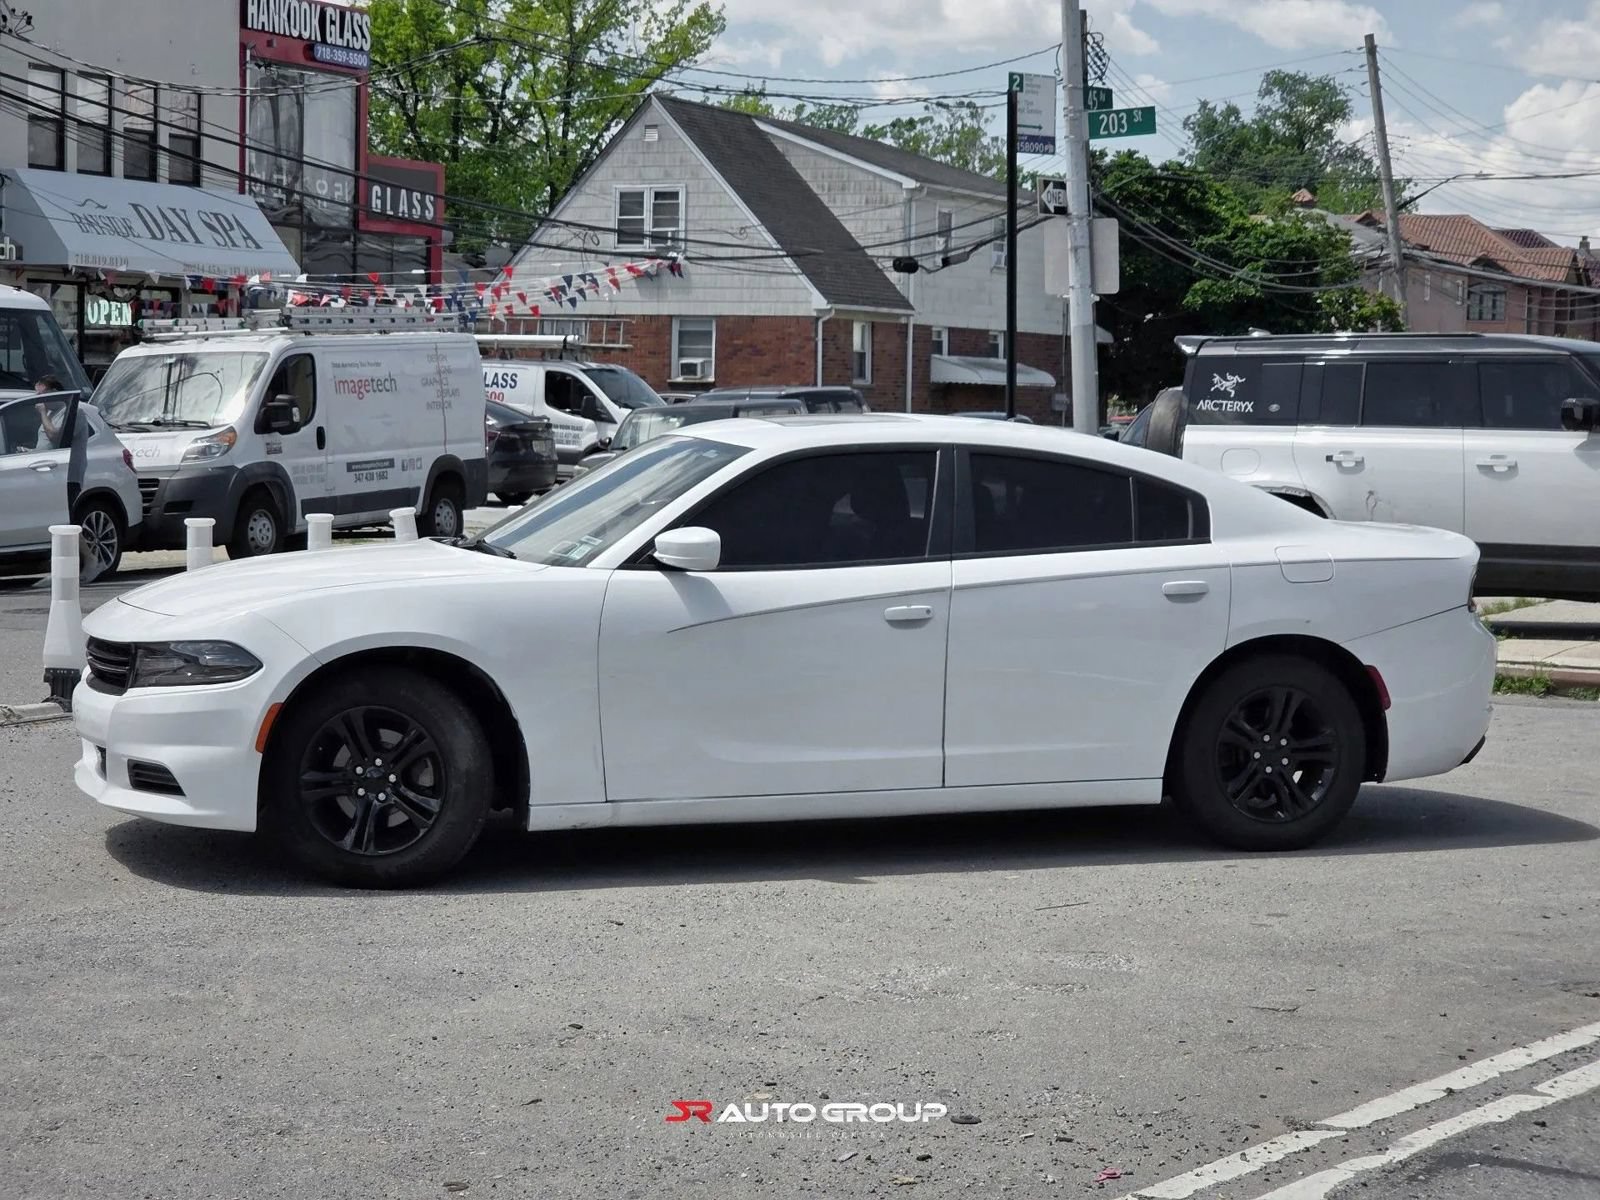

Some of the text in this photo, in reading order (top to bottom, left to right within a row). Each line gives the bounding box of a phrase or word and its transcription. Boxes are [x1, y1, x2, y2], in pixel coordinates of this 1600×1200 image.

[247, 0, 371, 52] HANKOOK GLASS
[316, 46, 368, 67] 718-359-5500
[1012, 75, 1020, 92] 2
[1099, 110, 1142, 135] 203 St
[371, 184, 435, 221] GLASS
[1046, 187, 1063, 206] ONE
[71, 202, 264, 250] BAYSIDE DAY SPA
[87, 300, 132, 326] OPEN
[333, 372, 398, 400] imagetech
